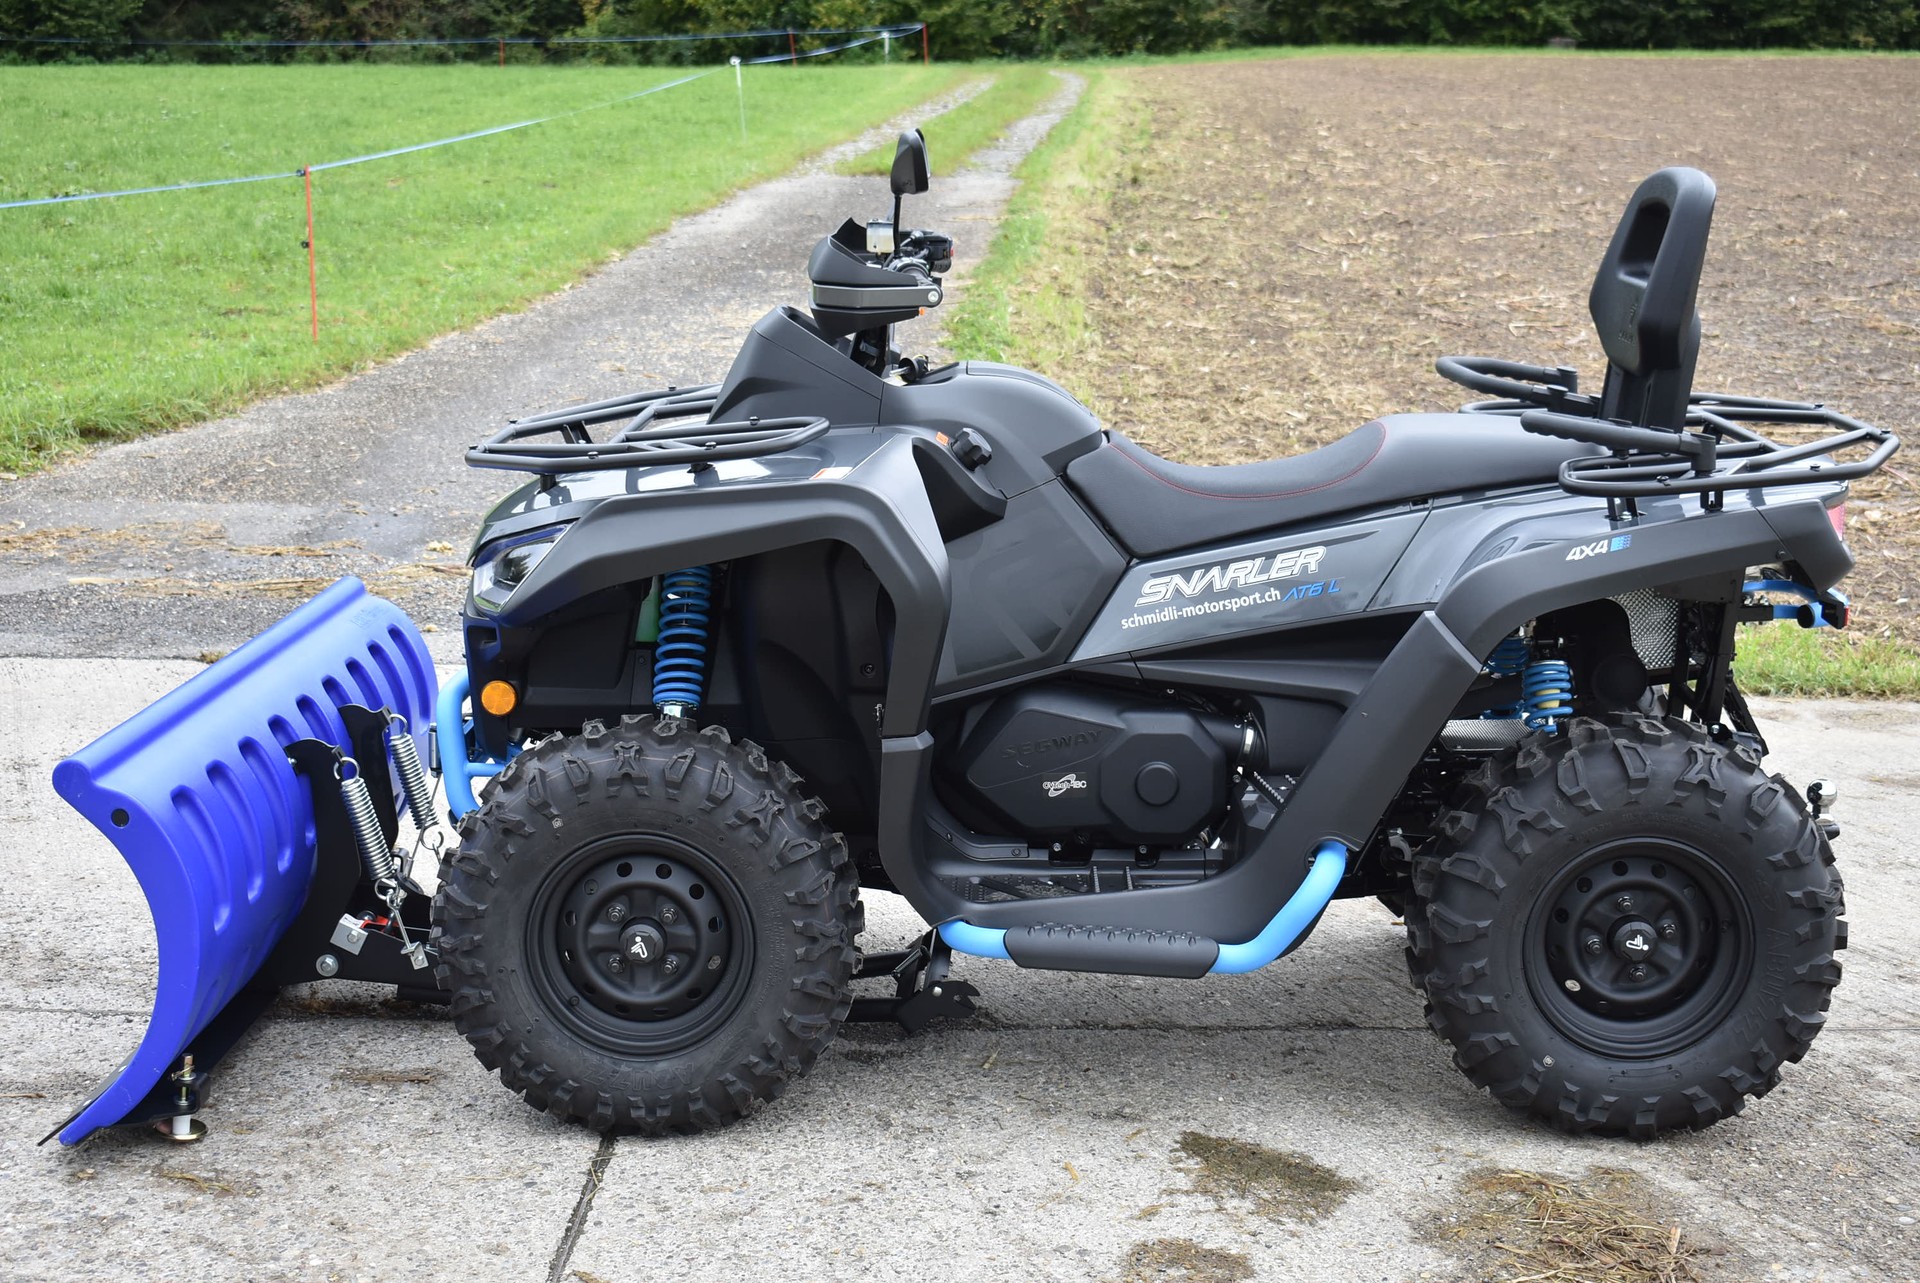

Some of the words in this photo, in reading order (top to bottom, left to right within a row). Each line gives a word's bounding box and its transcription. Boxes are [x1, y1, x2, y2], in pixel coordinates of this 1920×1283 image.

[1134, 545, 1327, 608] SNARLER
[1326, 579, 1342, 595] L
[1121, 587, 1282, 630] schmidli-motorsport.ch
[1001, 729, 1103, 760] SEGWAY
